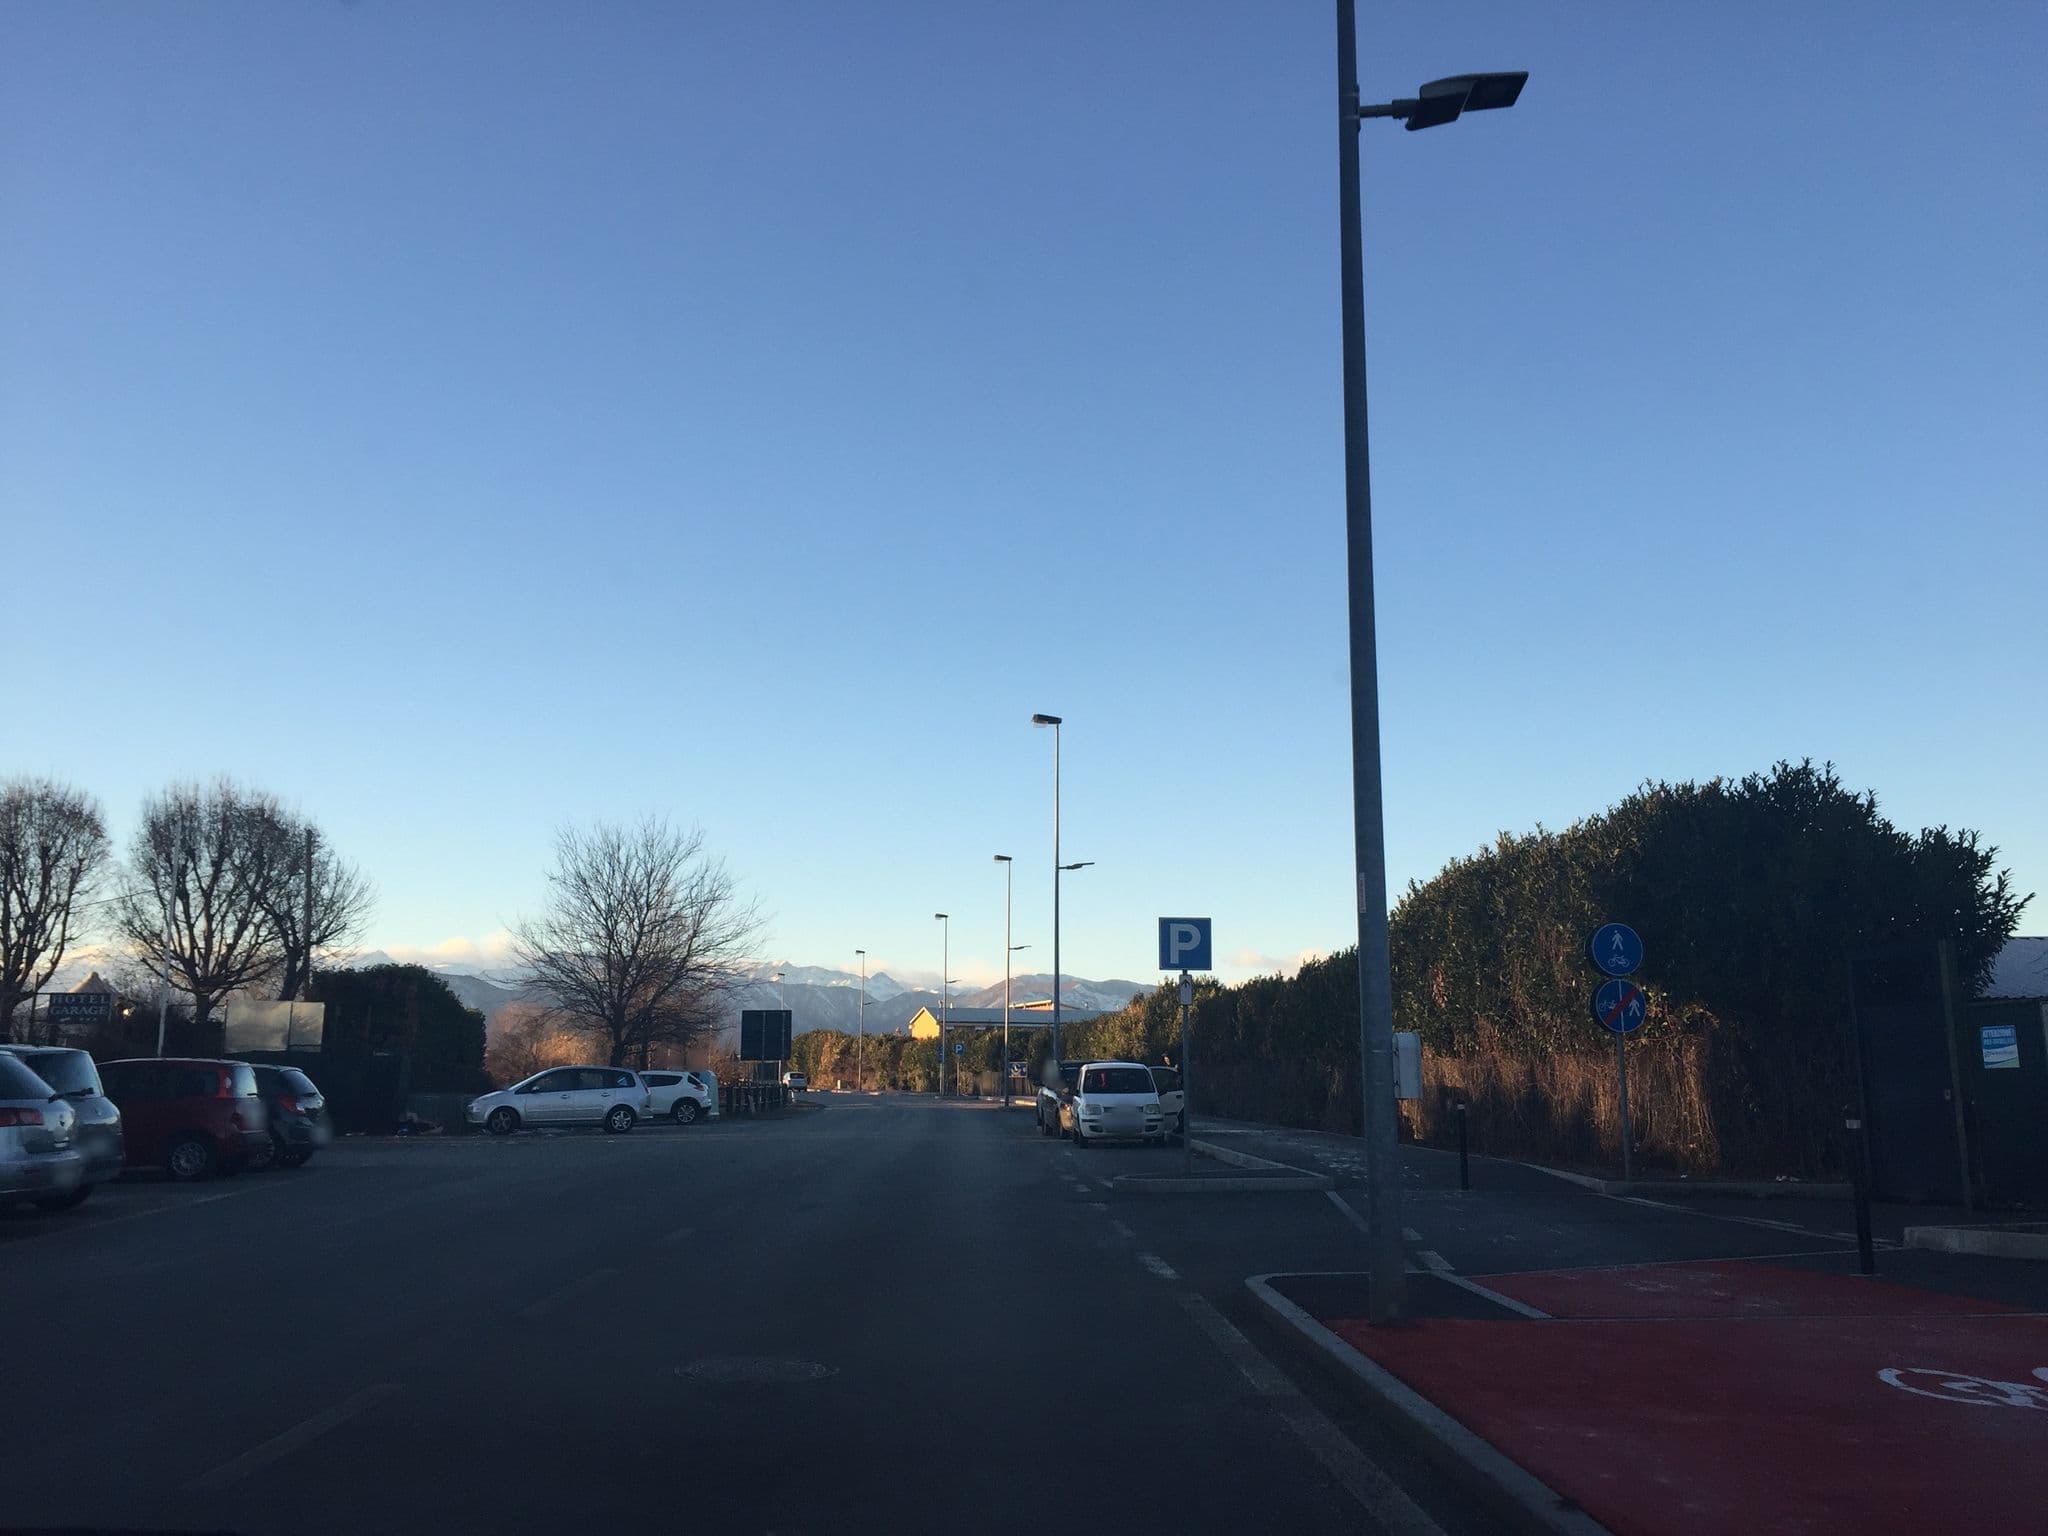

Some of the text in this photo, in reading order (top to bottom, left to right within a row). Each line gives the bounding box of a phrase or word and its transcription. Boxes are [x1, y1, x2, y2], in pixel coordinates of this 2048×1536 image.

[1170, 923, 1201, 964] P
[53, 994, 109, 1004] HOTEL
[50, 1006, 108, 1015] GARAGE
[955, 1044, 963, 1054] P
